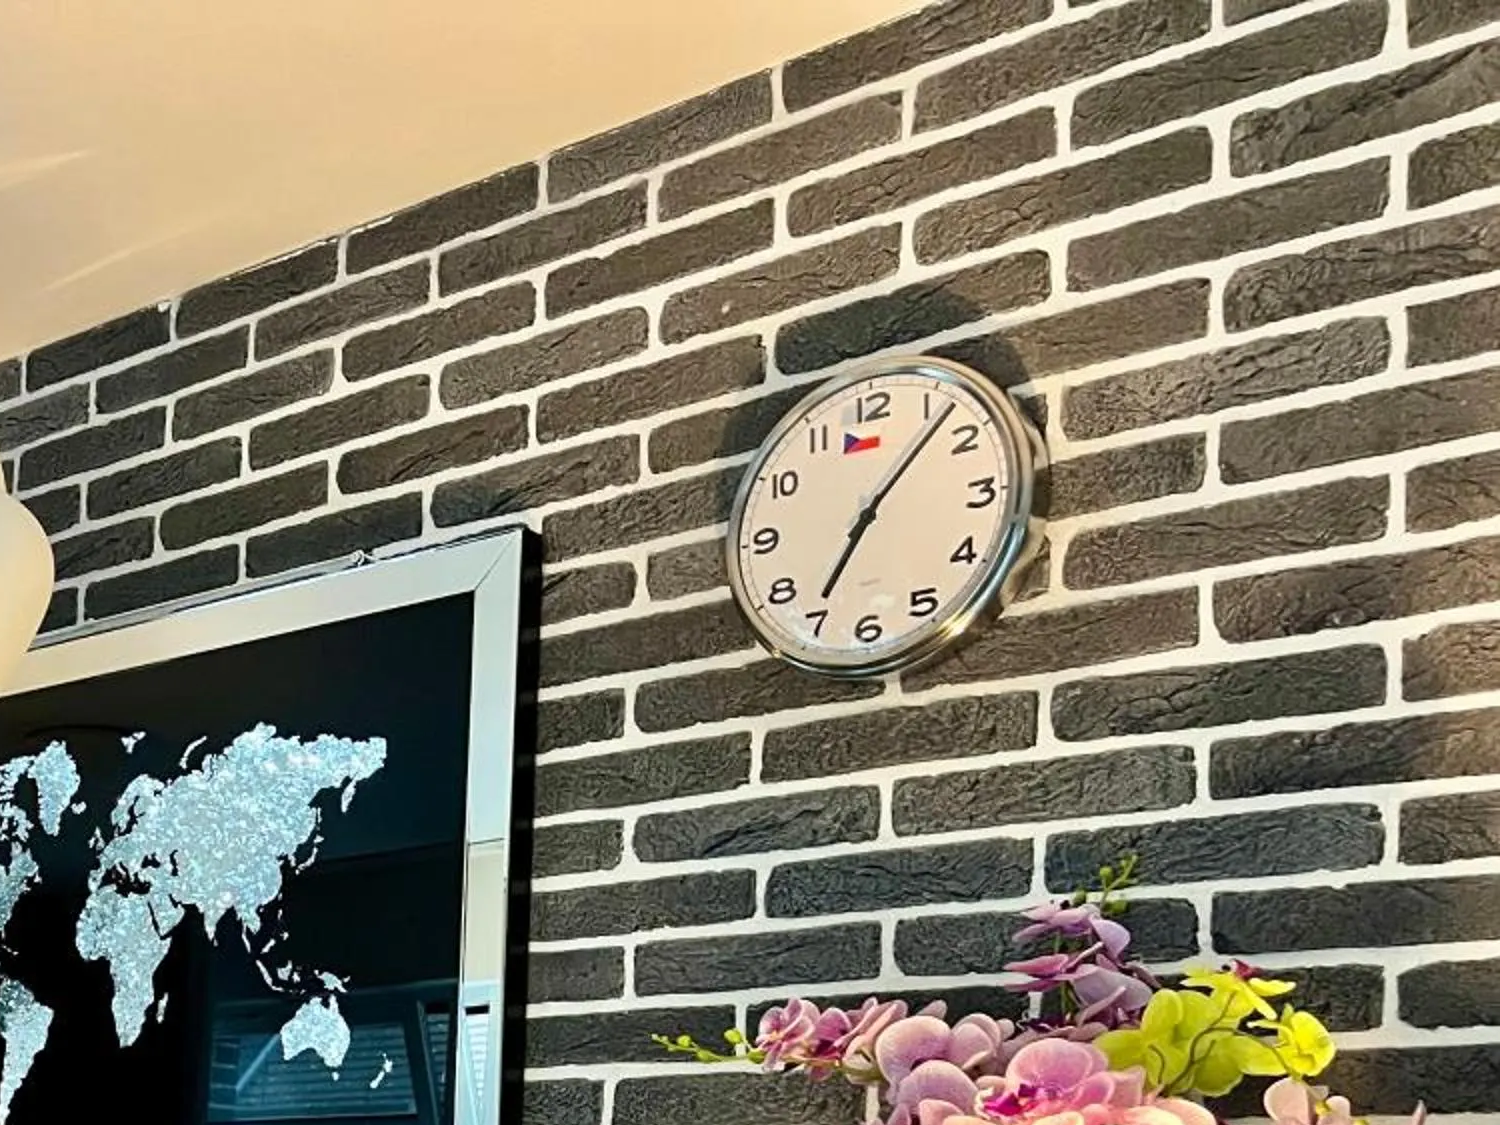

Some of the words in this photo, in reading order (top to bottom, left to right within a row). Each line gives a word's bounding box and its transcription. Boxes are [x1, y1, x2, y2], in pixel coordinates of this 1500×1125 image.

[857, 392, 891, 423] 12
[923, 393, 930, 420] 1
[810, 425, 828, 453] 11
[951, 425, 979, 455] 2
[772, 471, 799, 499] 10
[966, 477, 996, 508] 3
[753, 528, 779, 554] 9
[950, 537, 977, 564] 4
[768, 578, 797, 604] 8
[909, 588, 939, 616] 5
[806, 610, 828, 637] 7
[855, 615, 882, 643] 6
